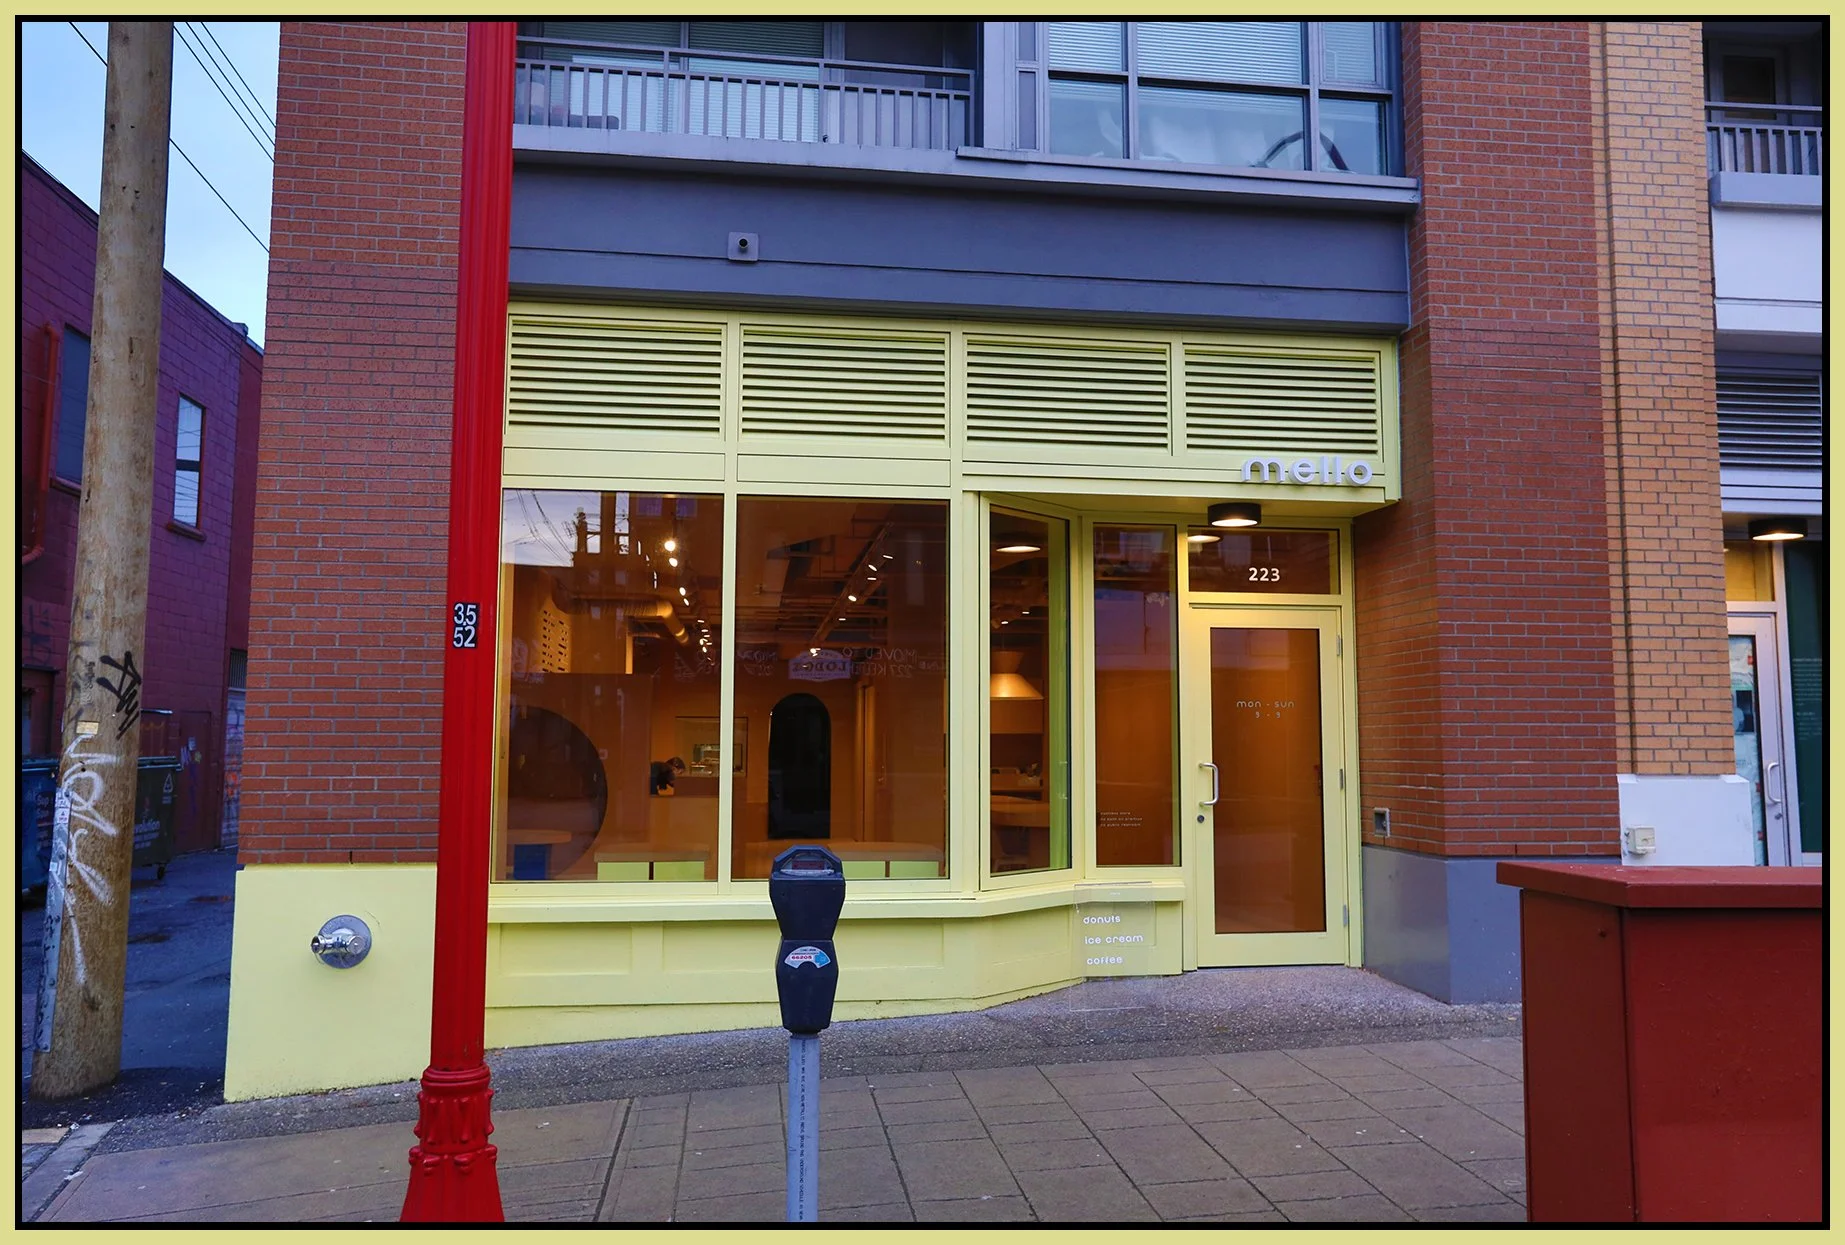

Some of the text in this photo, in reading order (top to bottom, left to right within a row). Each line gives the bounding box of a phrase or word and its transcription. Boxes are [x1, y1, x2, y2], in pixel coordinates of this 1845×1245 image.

[1241, 456, 1373, 486] mello
[1249, 567, 1280, 582] 223
[453, 626, 476, 648] 52
[1236, 700, 1262, 708] mon
[1274, 700, 1295, 708] sun
[1083, 915, 1121, 924] donuts
[1084, 935, 1144, 944] ice cream
[1086, 956, 1123, 965] coffee
